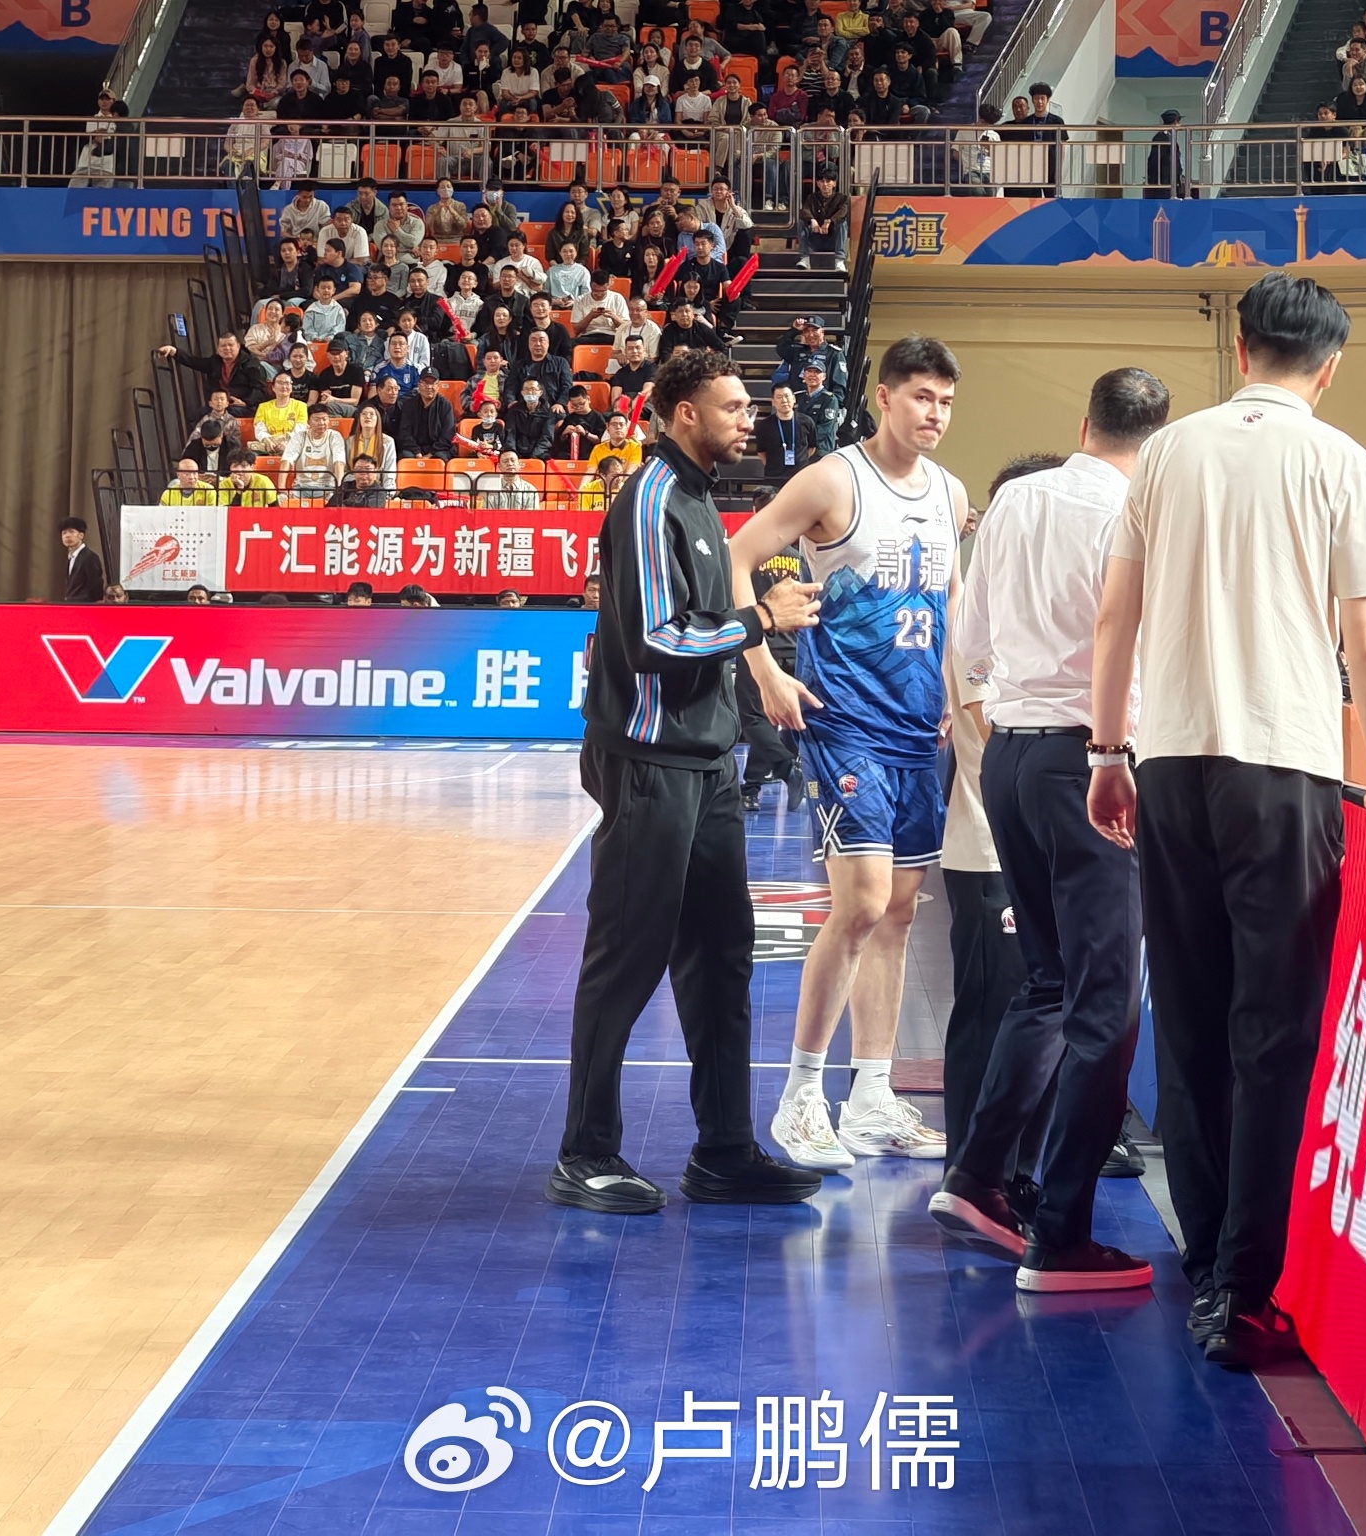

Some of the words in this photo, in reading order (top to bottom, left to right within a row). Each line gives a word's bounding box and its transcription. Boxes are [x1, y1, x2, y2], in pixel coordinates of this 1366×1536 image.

[1200, 11, 1229, 47] B
[82, 207, 191, 238] FLYING
[872, 215, 940, 255] 新疆
[875, 538, 947, 592] 新疆
[895, 608, 934, 649] 23
[171, 656, 445, 708] Valvoline
